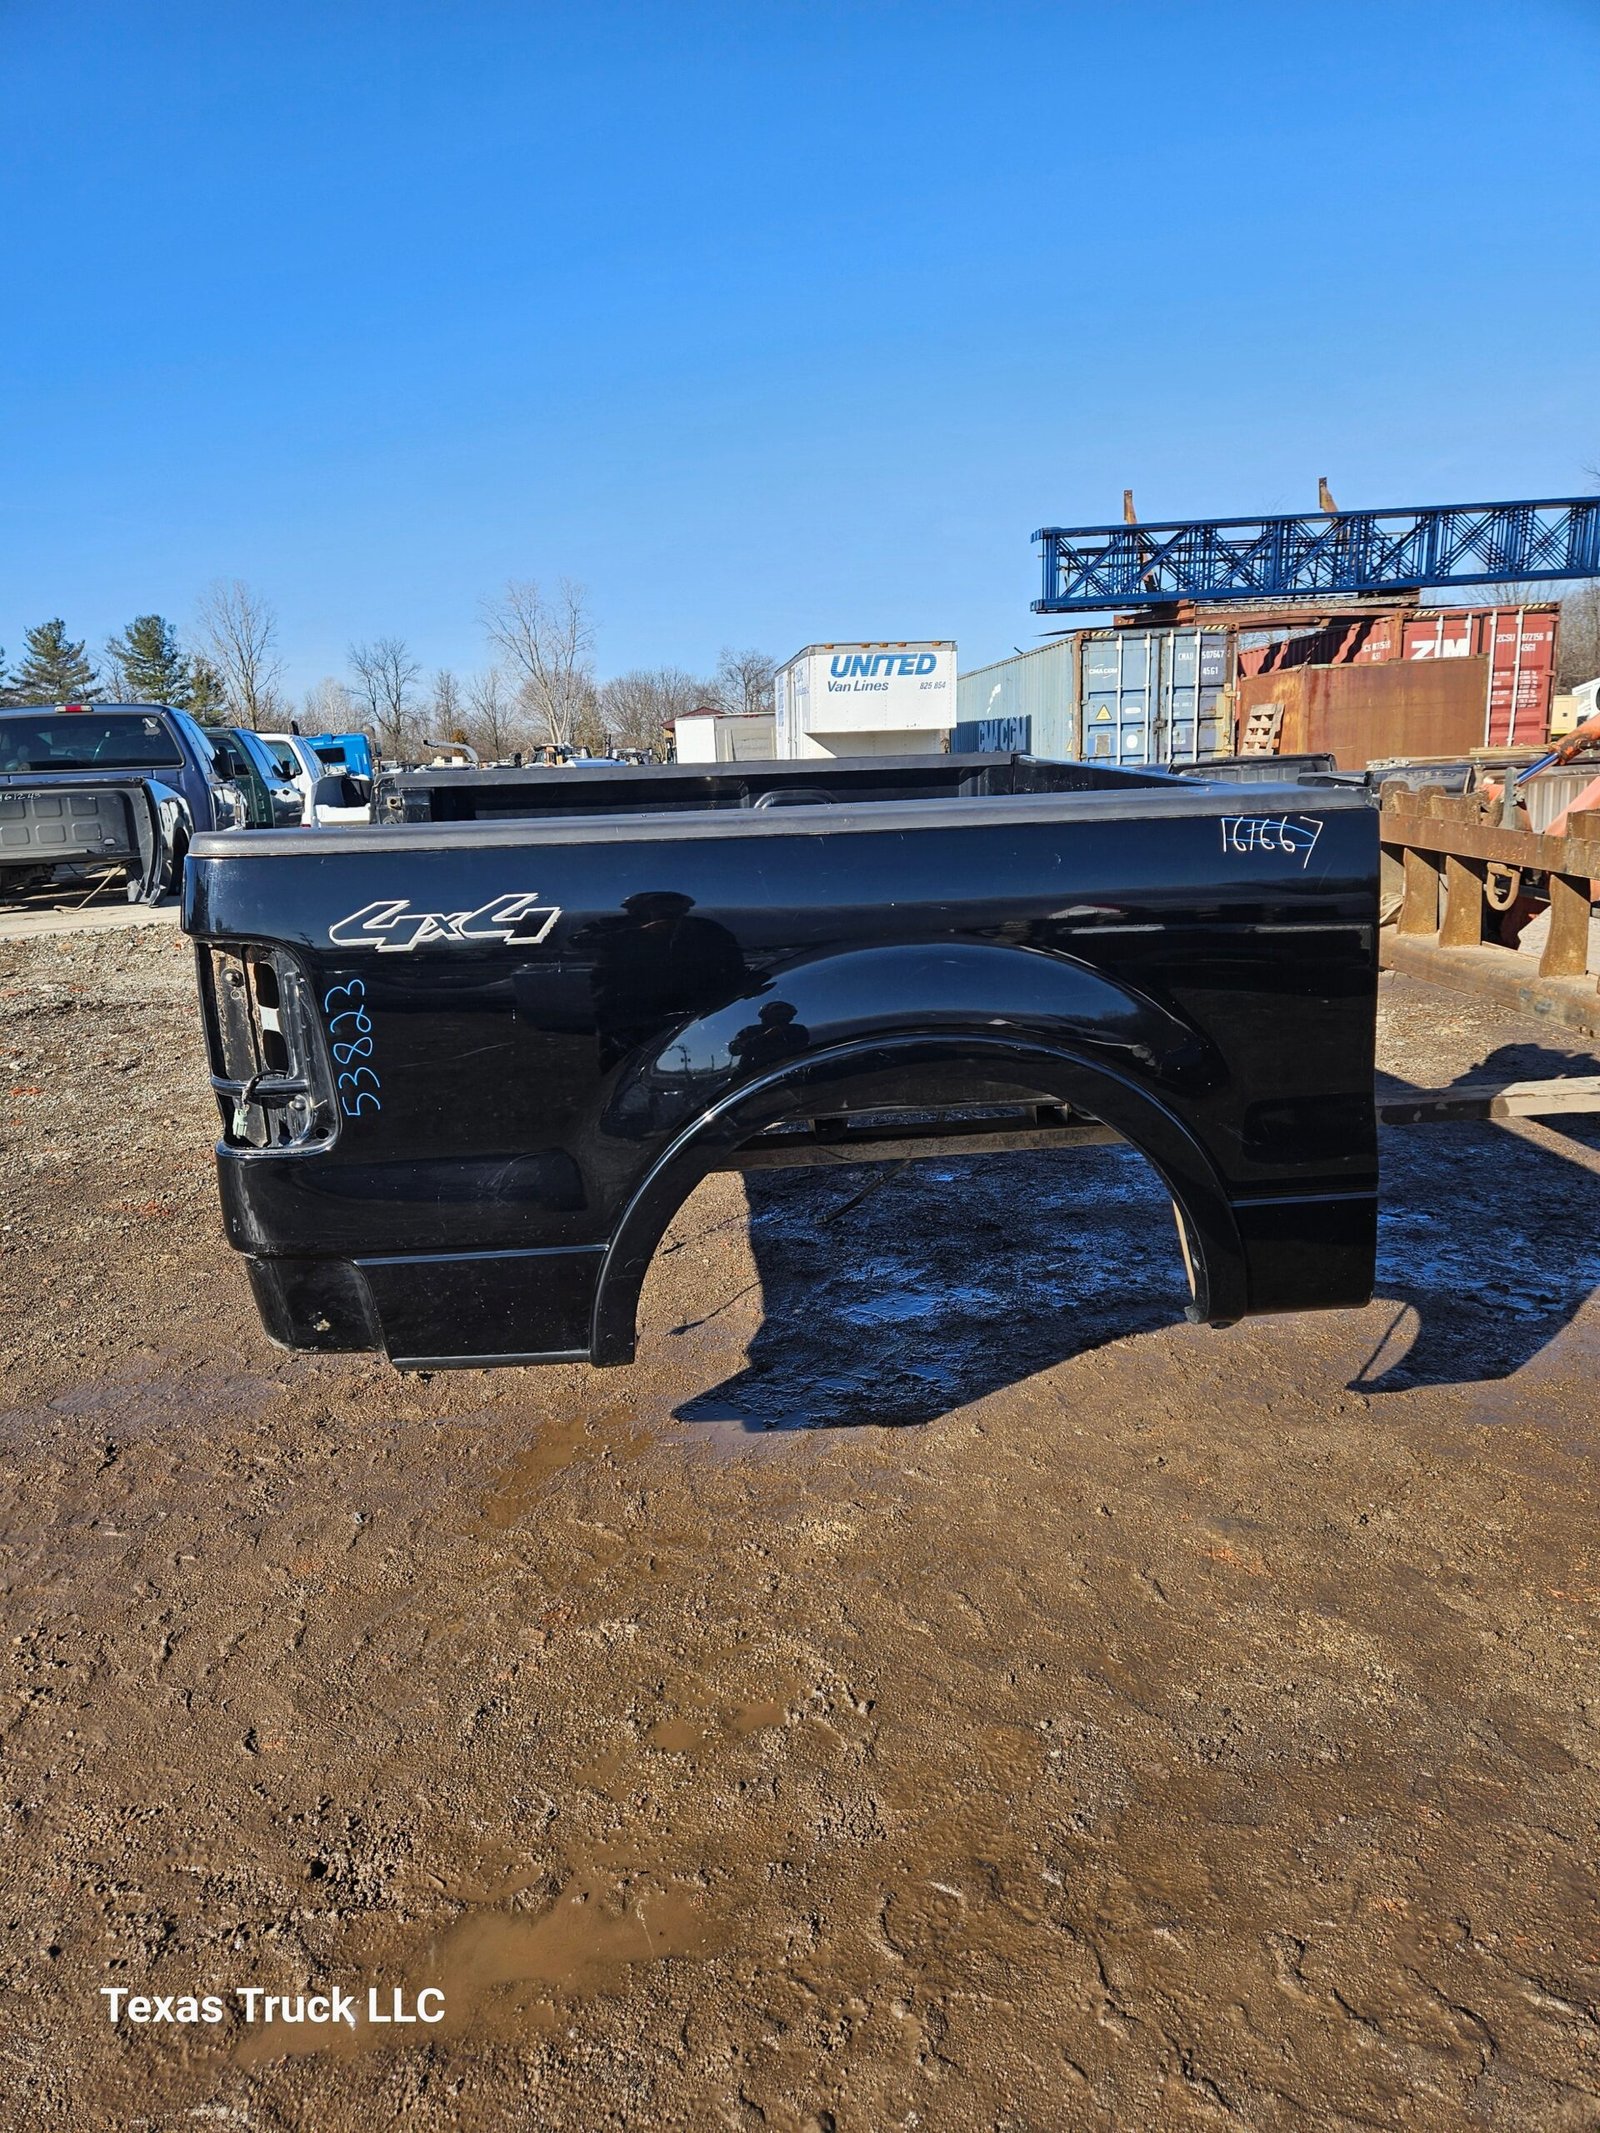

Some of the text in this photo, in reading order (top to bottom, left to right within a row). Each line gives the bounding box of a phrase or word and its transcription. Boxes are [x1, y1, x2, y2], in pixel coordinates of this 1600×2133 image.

[1411, 638, 1470, 660] ZIM
[830, 652, 938, 678] UNITED
[1202, 666, 1219, 676] 45G1
[827, 680, 890, 693] Van Lines
[920, 681, 933, 690] 825
[1000, 717, 1027, 752] CGM
[329, 892, 564, 953] 4x4
[324, 978, 381, 1116] 53823
